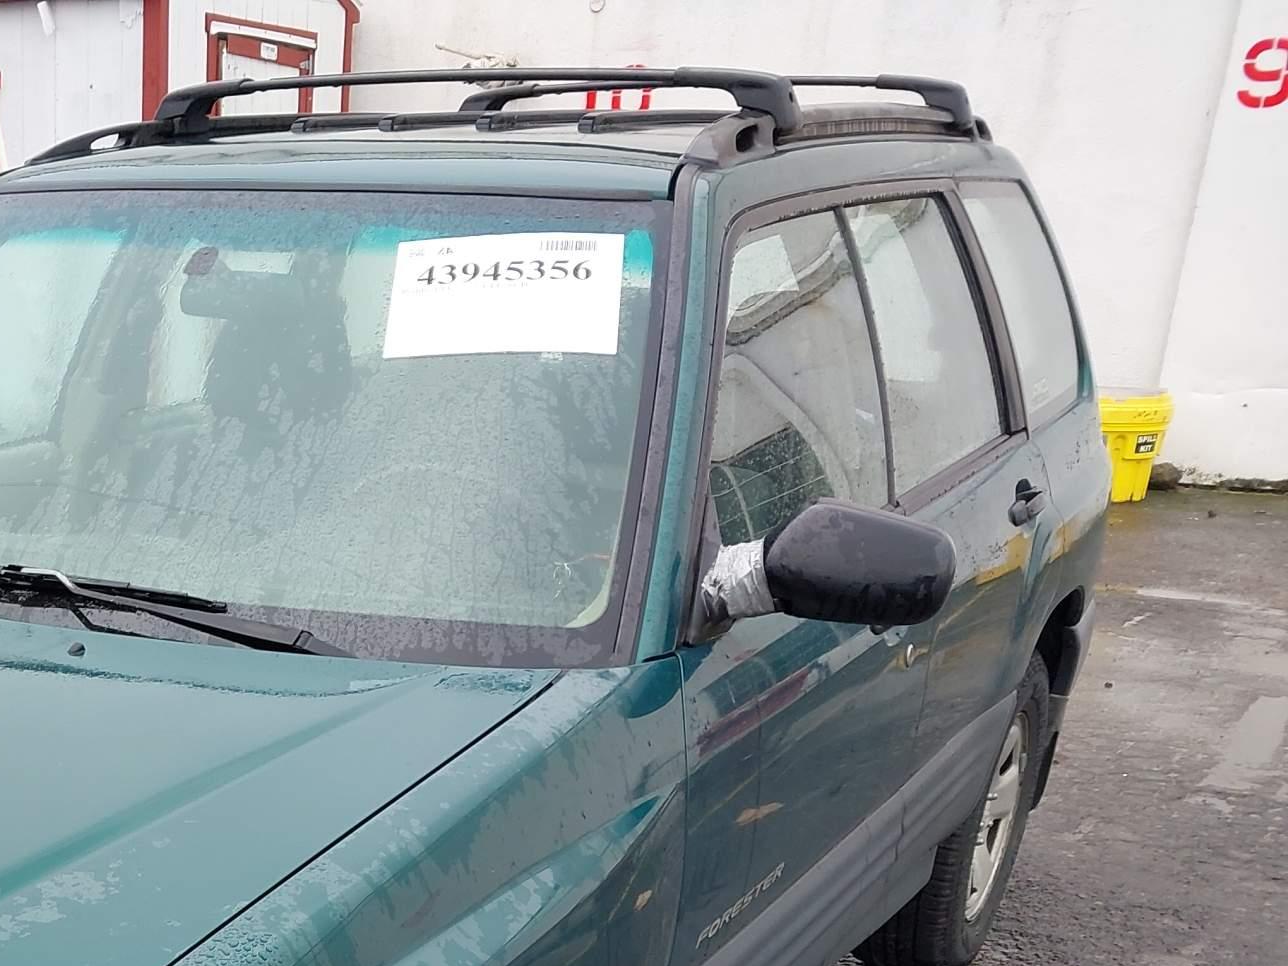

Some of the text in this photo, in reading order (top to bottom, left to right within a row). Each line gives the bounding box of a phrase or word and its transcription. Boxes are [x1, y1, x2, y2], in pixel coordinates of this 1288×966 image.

[1237, 38, 1288, 109] 9
[416, 259, 593, 286] 43945356
[696, 862, 785, 949] FORESTER
